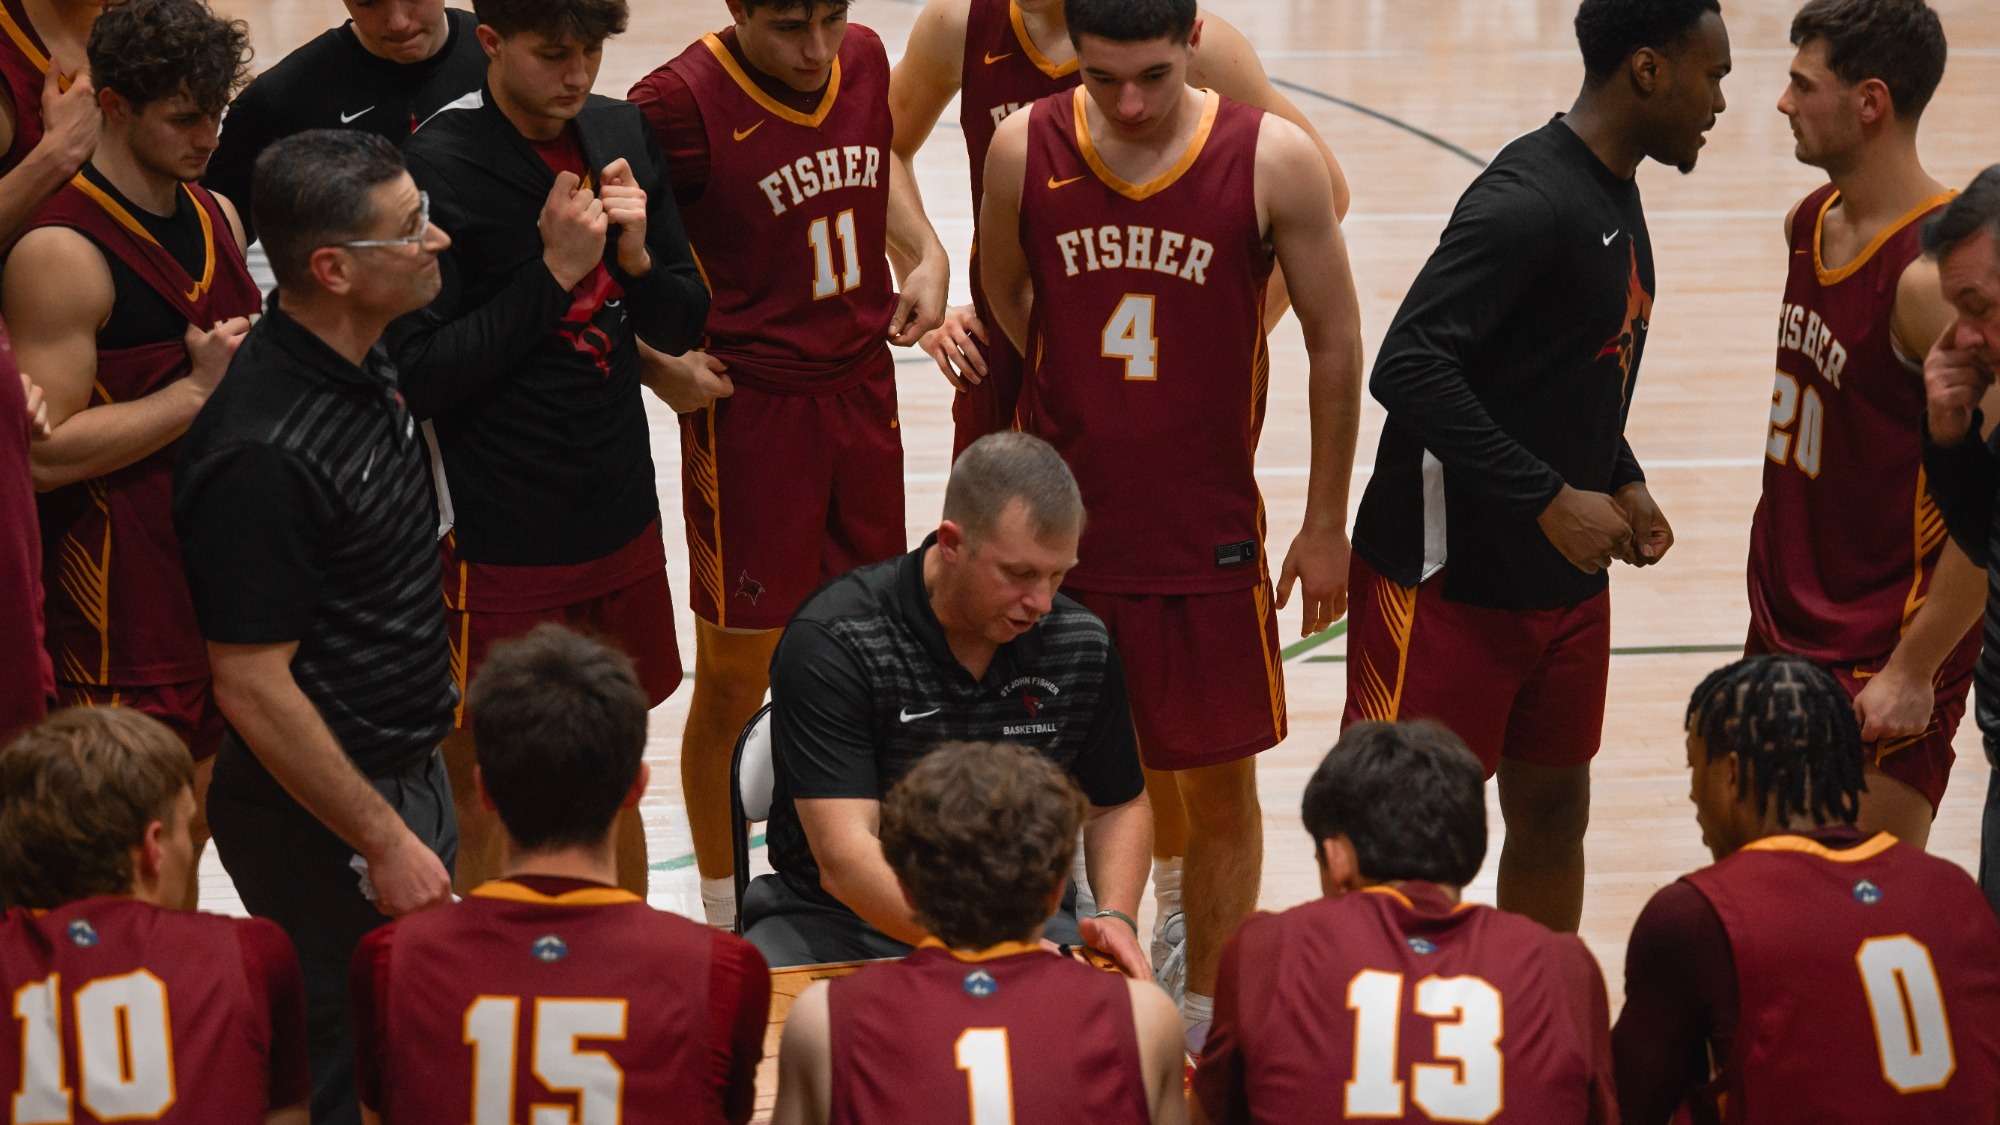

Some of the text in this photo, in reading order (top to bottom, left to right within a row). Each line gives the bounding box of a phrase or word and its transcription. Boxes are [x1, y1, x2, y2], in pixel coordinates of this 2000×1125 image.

[757, 145, 880, 217] FISHER
[807, 208, 861, 300] 11
[1055, 224, 1215, 286] FISHER
[1101, 293, 1159, 381] 4
[1766, 368, 1824, 480] 20
[1003, 722, 1058, 736] BASKETBALL
[1011, 676, 1031, 689] JOHN
[1032, 676, 1060, 696] FISHER
[11, 967, 176, 1125] 10
[462, 994, 629, 1125] 15
[1343, 968, 1505, 1125] 13
[1854, 932, 1958, 1095] 0
[953, 1026, 1016, 1125] 1
